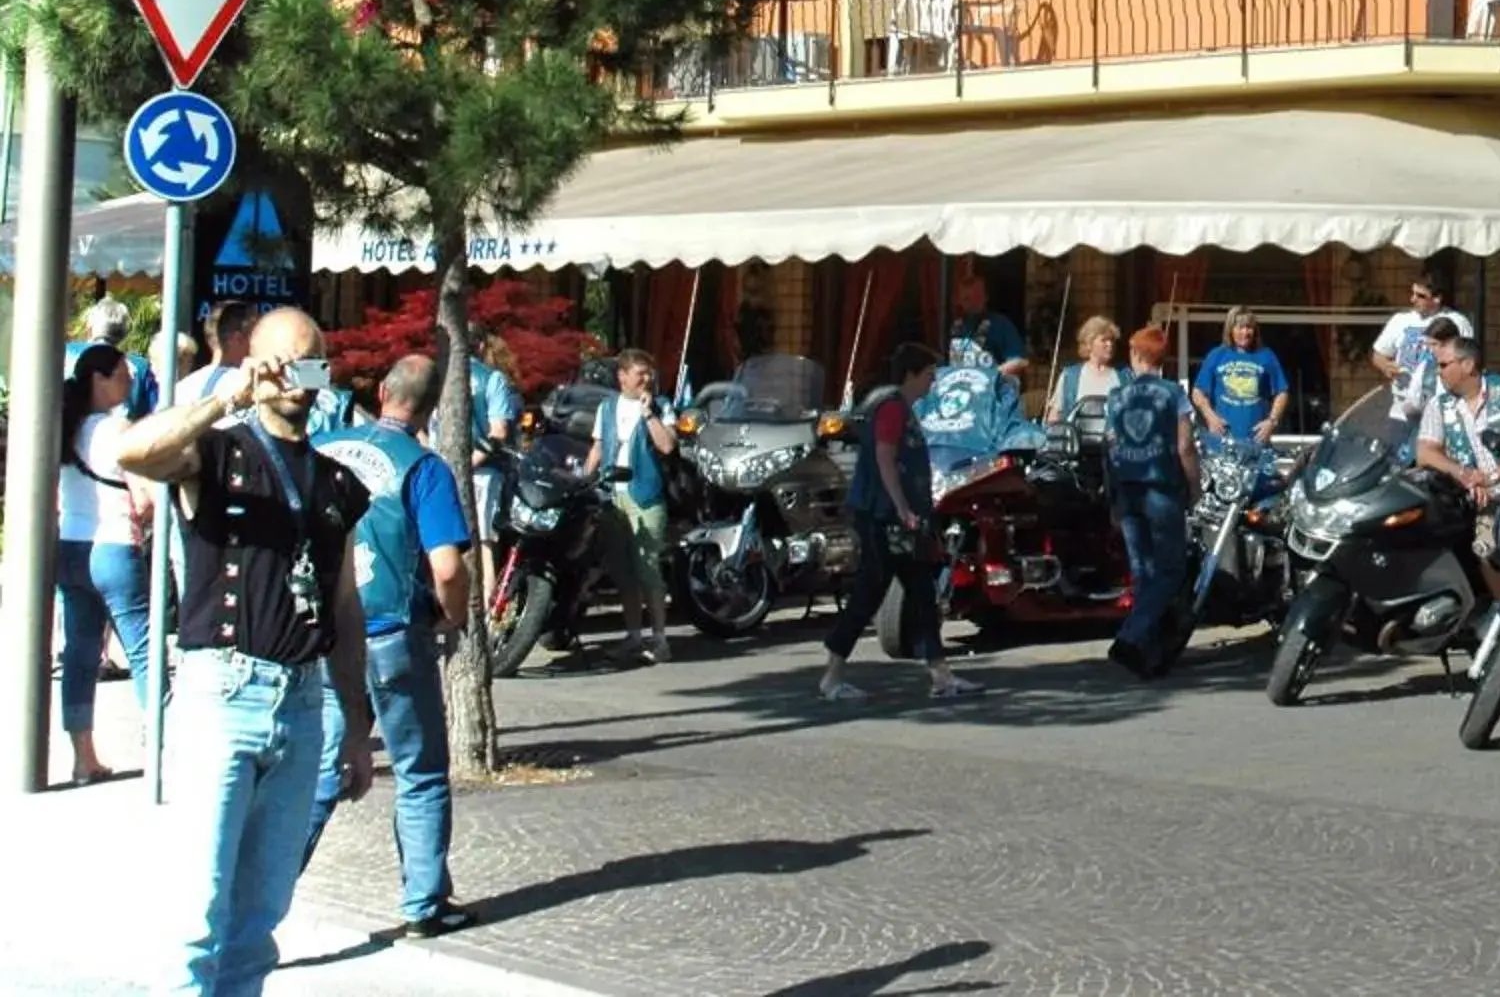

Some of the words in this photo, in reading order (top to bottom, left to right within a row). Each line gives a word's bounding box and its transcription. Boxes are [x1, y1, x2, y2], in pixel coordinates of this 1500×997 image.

[362, 238, 417, 262] HOTEL
[424, 236, 512, 262] ARRA
[213, 273, 293, 296] HOTEL
